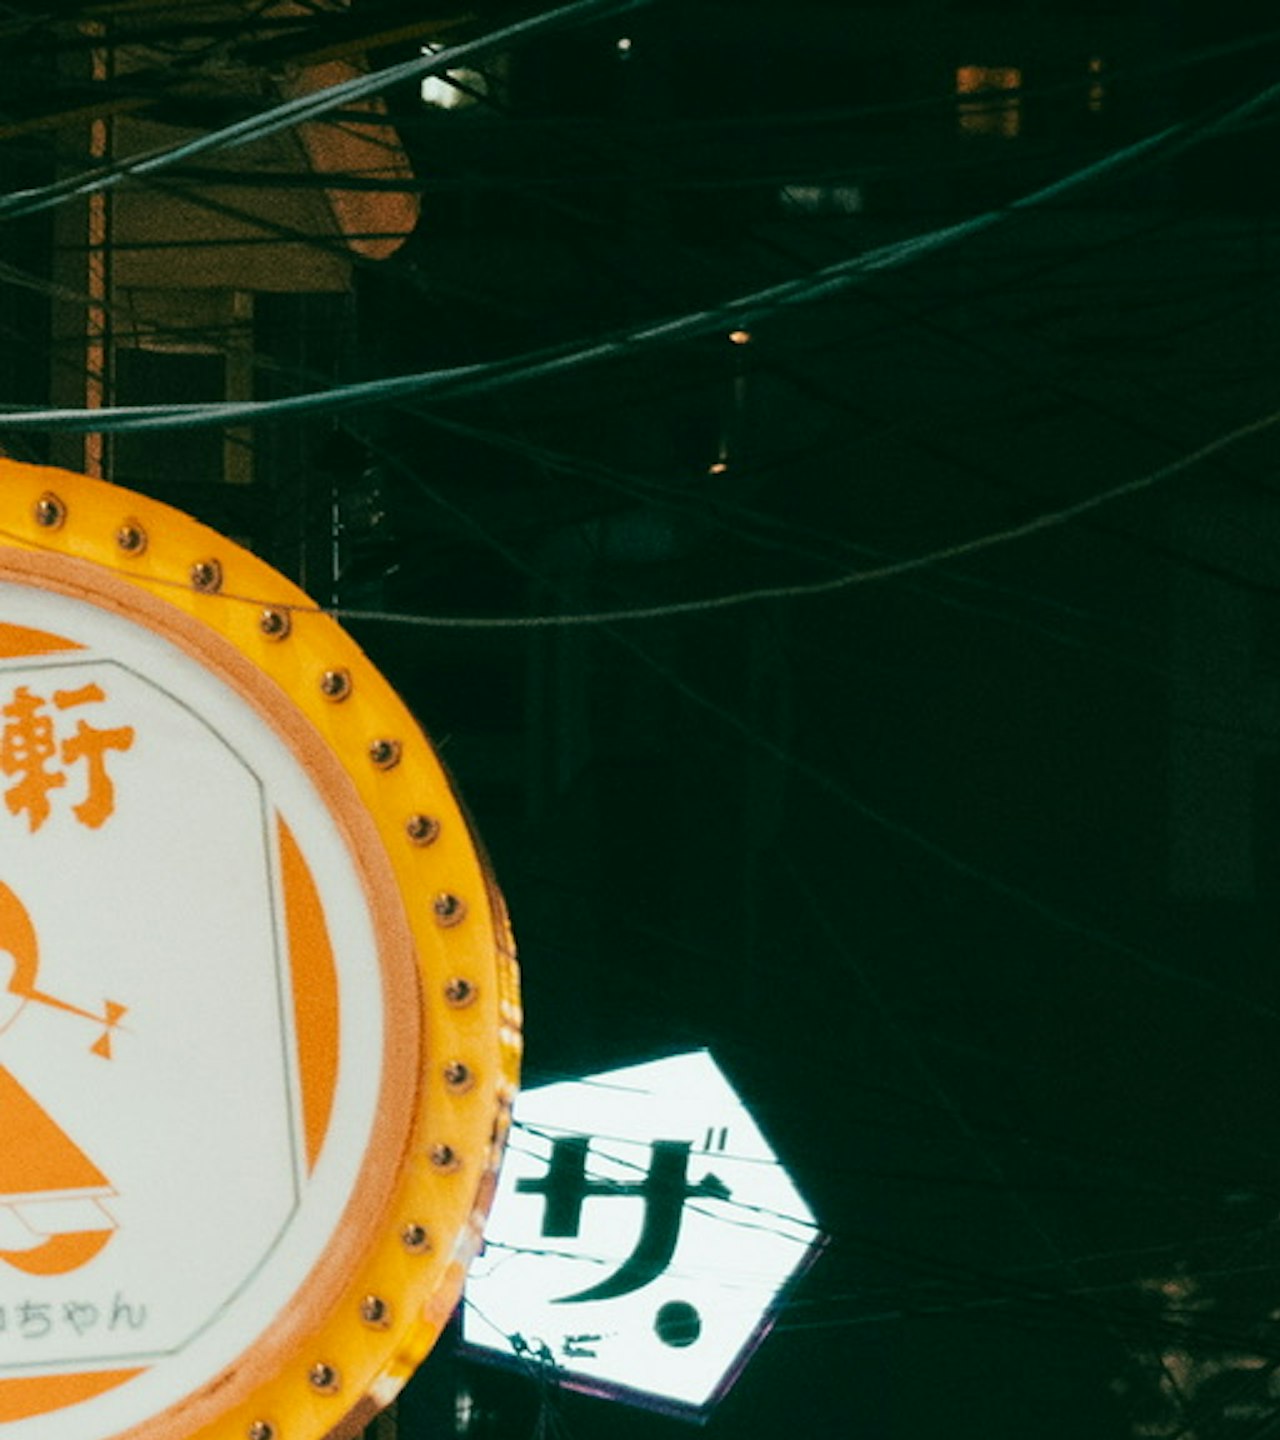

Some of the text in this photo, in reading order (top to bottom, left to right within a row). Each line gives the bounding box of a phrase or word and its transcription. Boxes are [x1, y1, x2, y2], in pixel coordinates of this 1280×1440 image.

[2, 681, 136, 835] 軒
[0, 1288, 148, 1340] ちゃん
